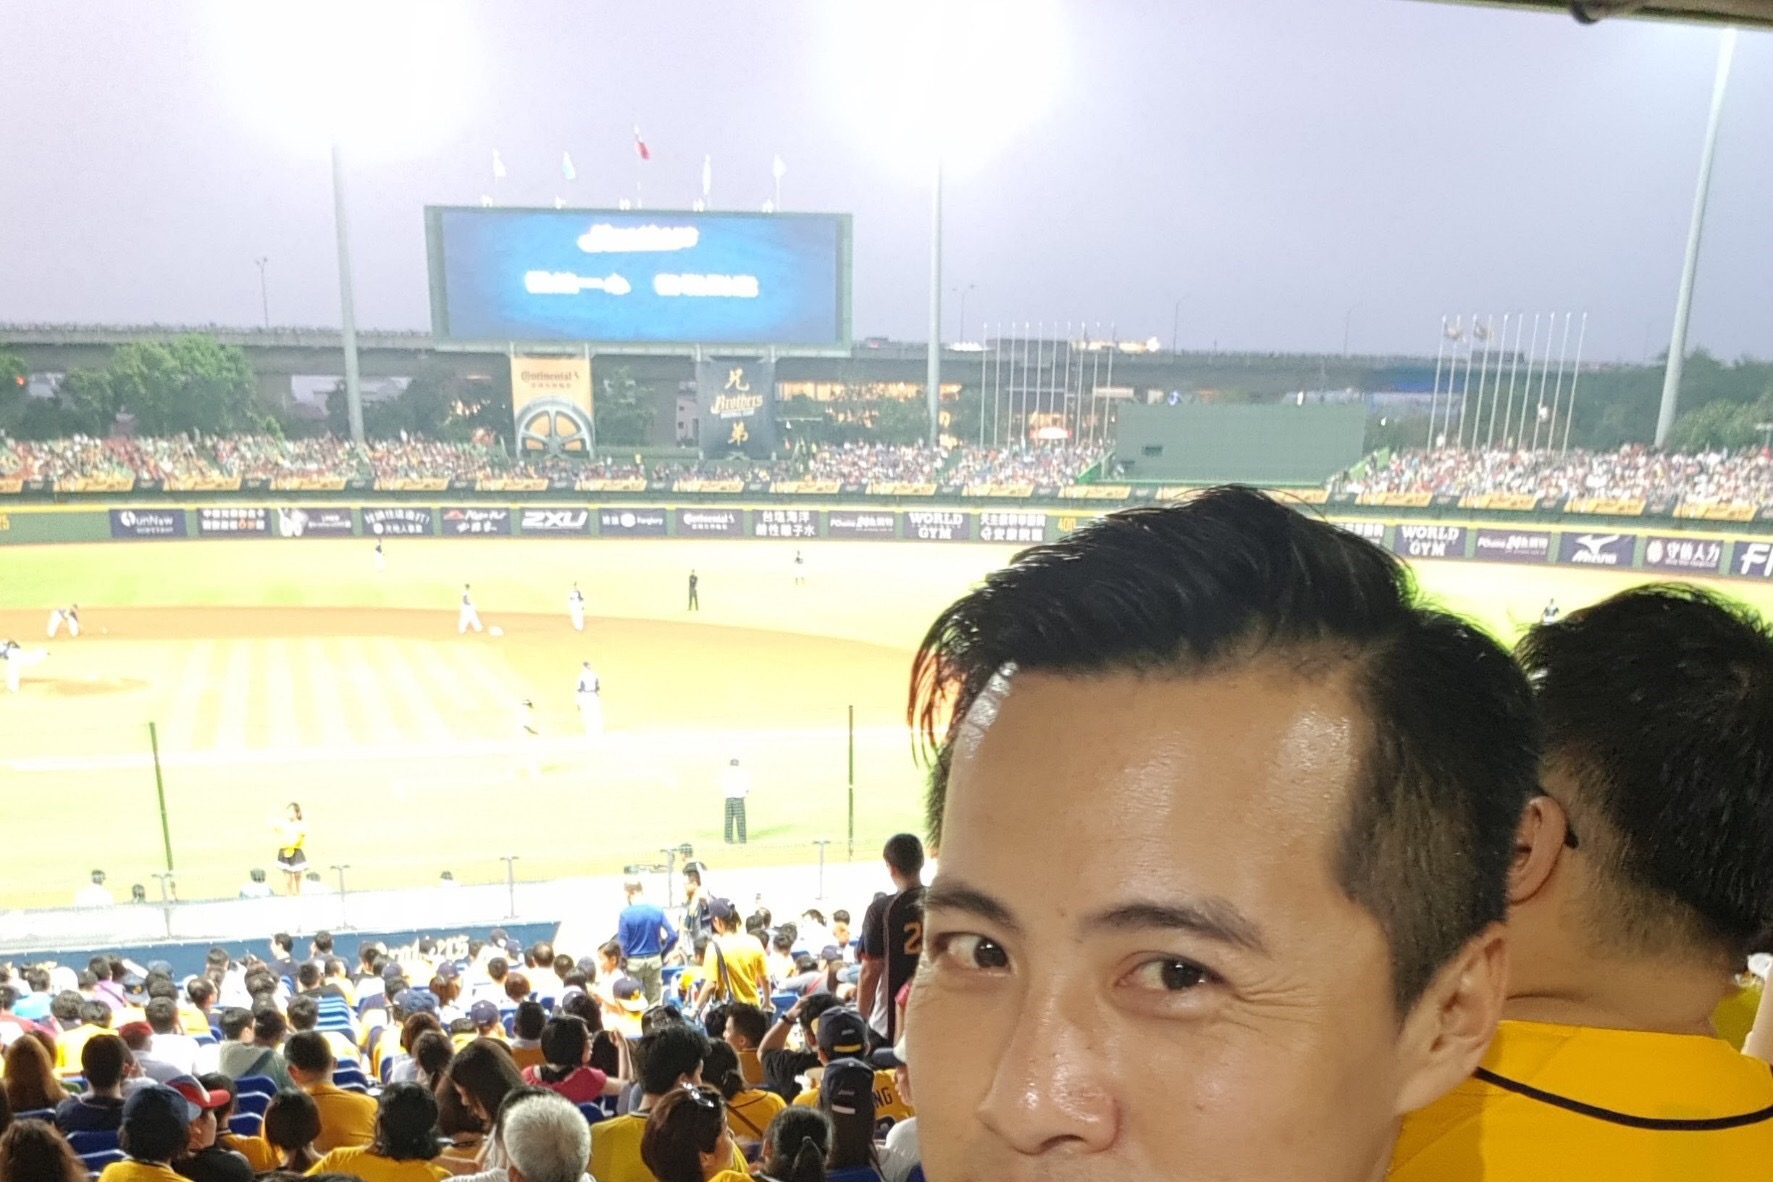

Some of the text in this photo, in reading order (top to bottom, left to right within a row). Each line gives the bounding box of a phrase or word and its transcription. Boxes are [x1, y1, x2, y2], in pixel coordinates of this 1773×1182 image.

[724, 368, 750, 391] 兄
[710, 394, 763, 415] Brothers
[727, 421, 749, 446] 弟
[522, 510, 589, 529] 2XU
[909, 512, 963, 525] WORLD
[918, 527, 952, 539] GYM
[1401, 525, 1460, 541] WORLD
[1409, 541, 1447, 556] GYM
